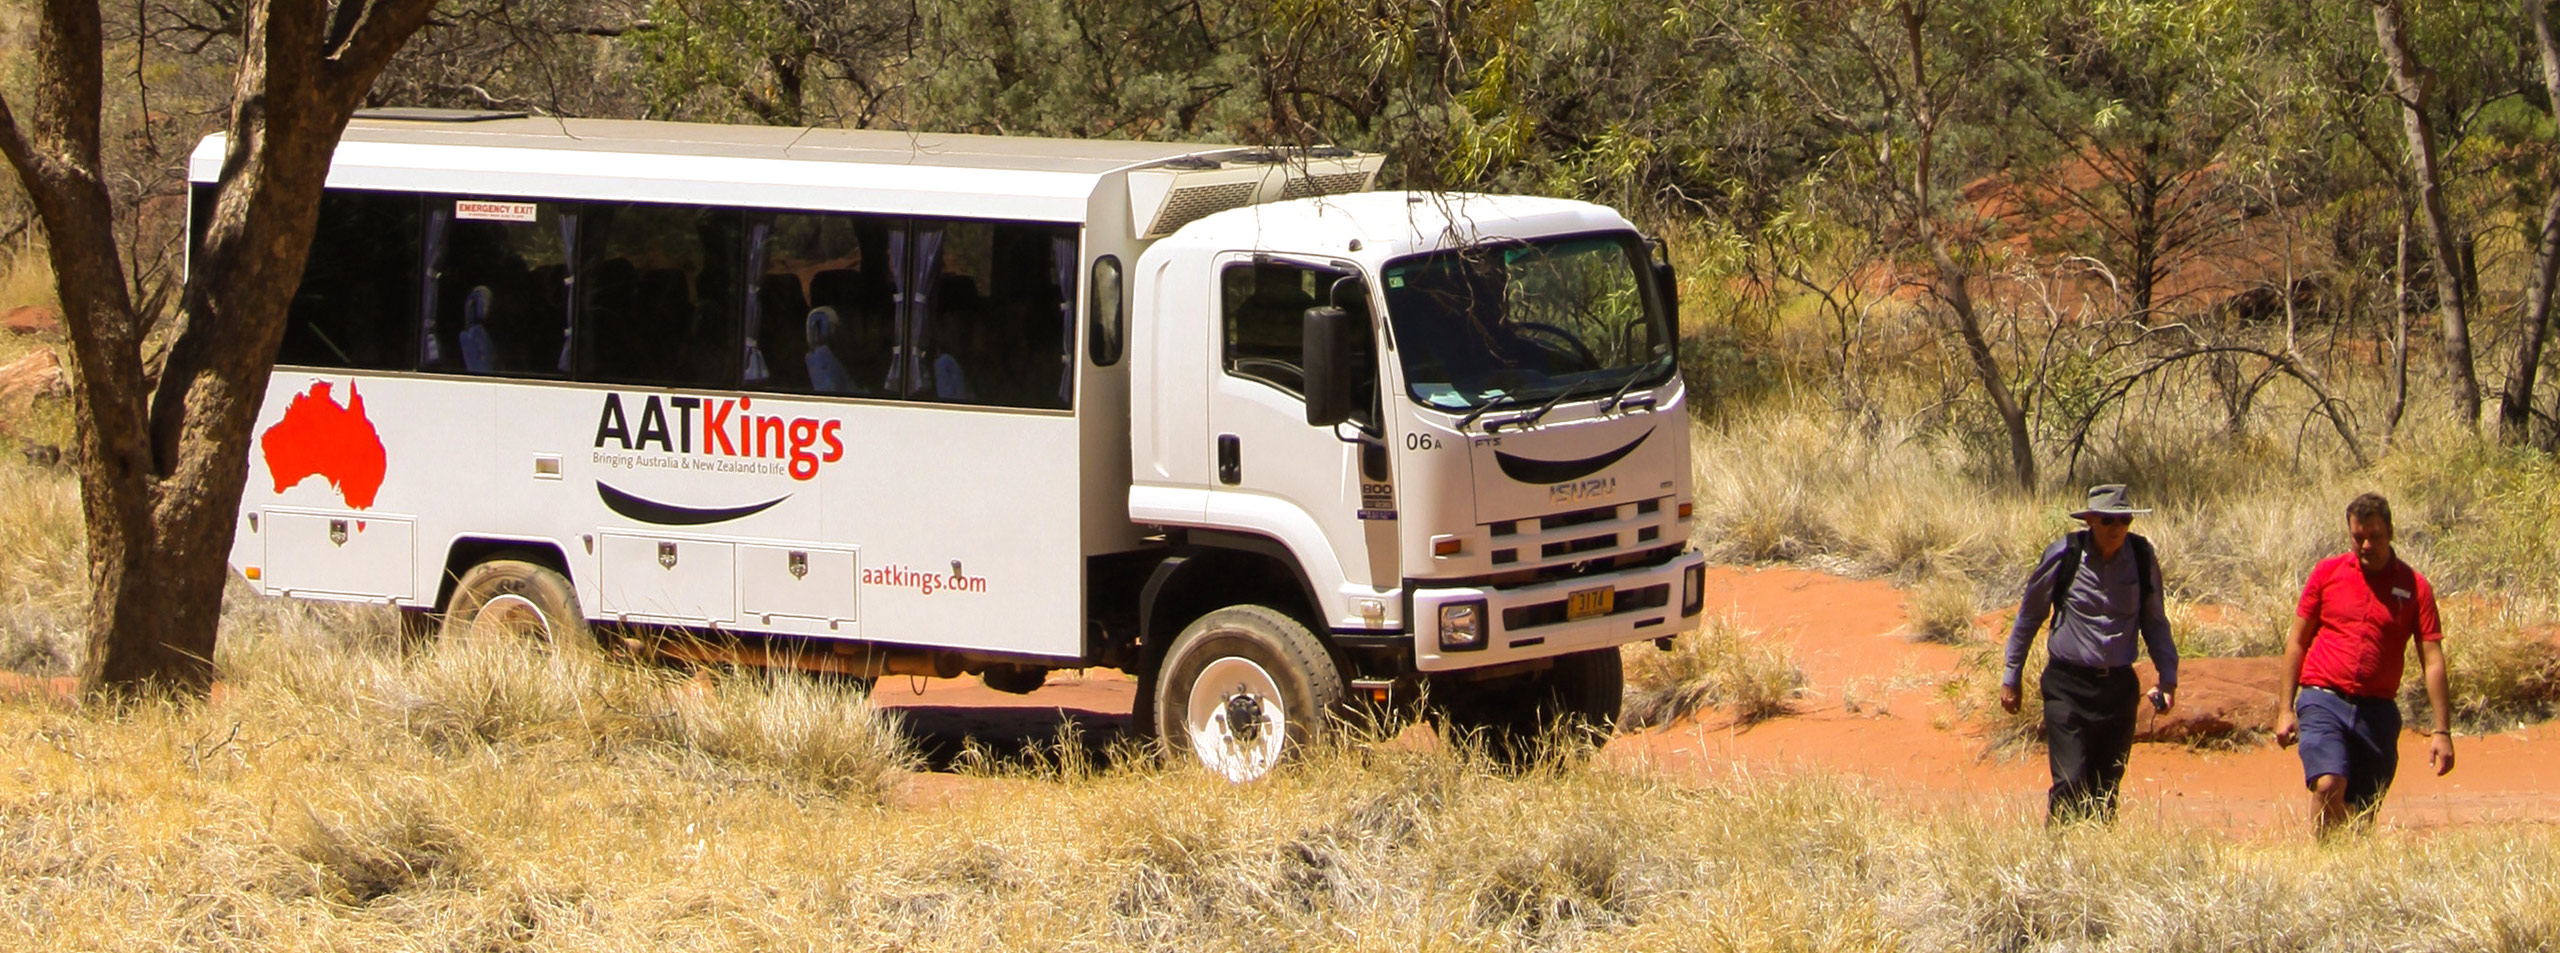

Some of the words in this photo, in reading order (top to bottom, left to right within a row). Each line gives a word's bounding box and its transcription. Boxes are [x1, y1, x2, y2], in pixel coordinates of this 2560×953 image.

[458, 203, 510, 214] EMERGENCY
[514, 205, 534, 215] EXIT
[592, 452, 633, 469] Bringing
[636, 455, 678, 469] Australia
[681, 457, 690, 469] &
[693, 459, 714, 472] New
[717, 460, 755, 474] Zealand
[757, 462, 767, 475] to
[769, 462, 785, 475] life
[1362, 484, 1392, 494] 800
[1549, 477, 1616, 505] ISUZU
[862, 564, 987, 595] aatkings.com
